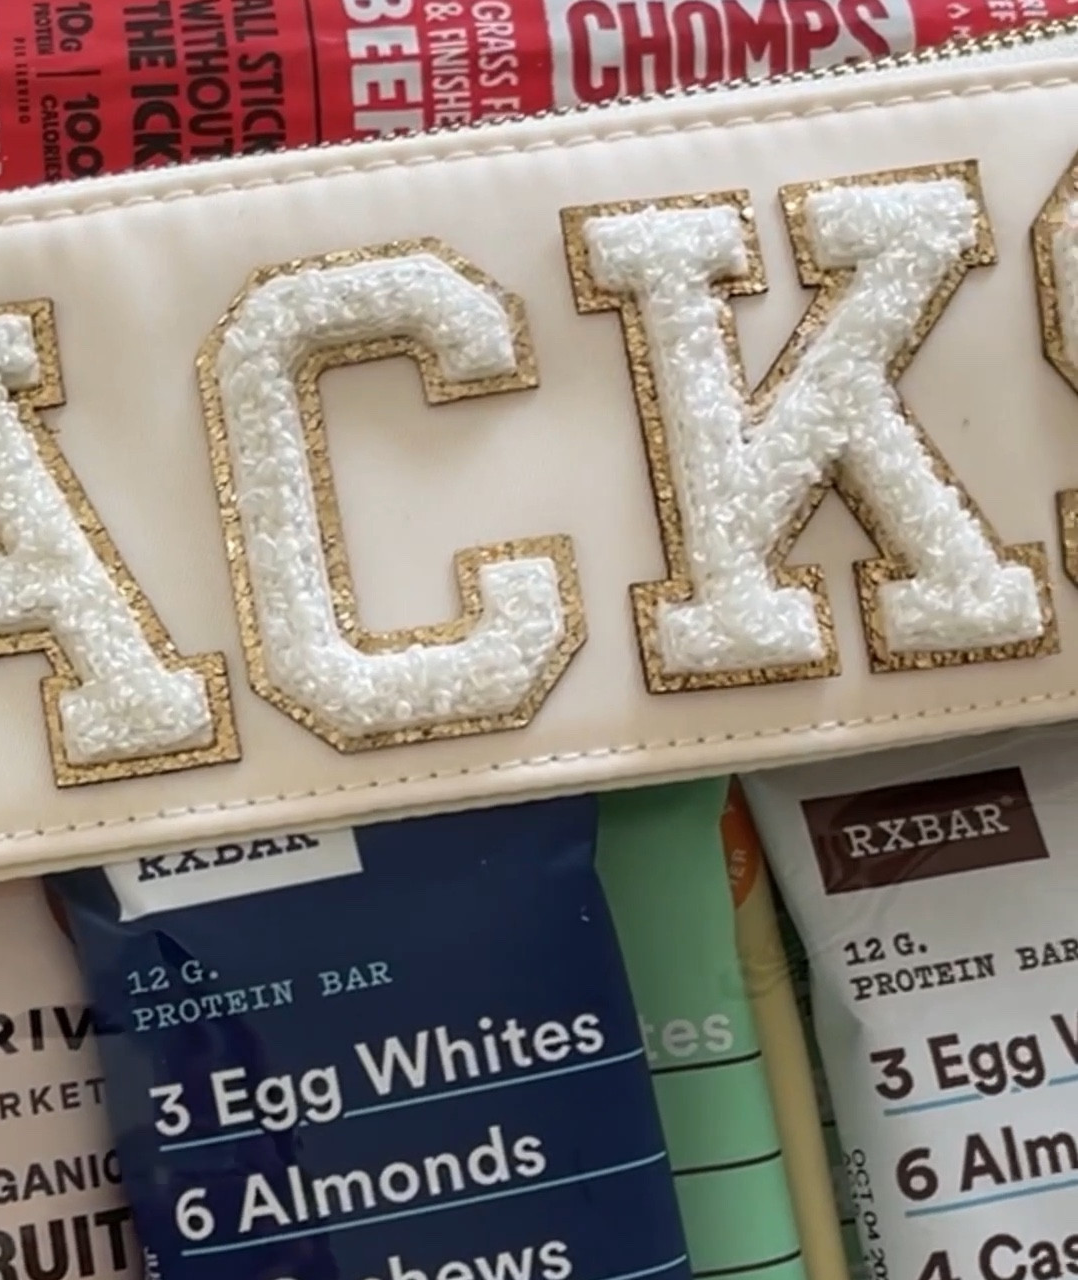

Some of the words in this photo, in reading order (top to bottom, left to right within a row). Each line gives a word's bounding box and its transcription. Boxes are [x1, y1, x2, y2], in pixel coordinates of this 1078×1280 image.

[32, 2, 55, 56] PROTEIN
[55, 1, 94, 53] 10G
[123, 0, 178, 72] THE
[423, 1, 464, 22] &
[471, 0, 520, 88] GRASS
[40, 94, 63, 183] CALORIES
[63, 92, 104, 178] 100
[131, 83, 184, 167] ICK
[842, 801, 1011, 861] RXBAR
[128, 964, 171, 997] 12
[180, 958, 222, 986] G.
[843, 937, 886, 968] 12
[893, 932, 929, 958] G.
[850, 953, 996, 1002] PROTEIN
[1015, 935, 1078, 973] BAR
[133, 979, 295, 1033] PROTEIN
[320, 960, 394, 998] BAR
[149, 1084, 193, 1137] 3
[211, 1062, 345, 1132] Egg
[353, 1011, 606, 1098] Whites
[870, 1047, 915, 1101] 3
[926, 1032, 1046, 1096] Egg
[174, 1187, 216, 1242] 6
[238, 1124, 548, 1235] Almonds
[895, 1146, 939, 1202] 6
